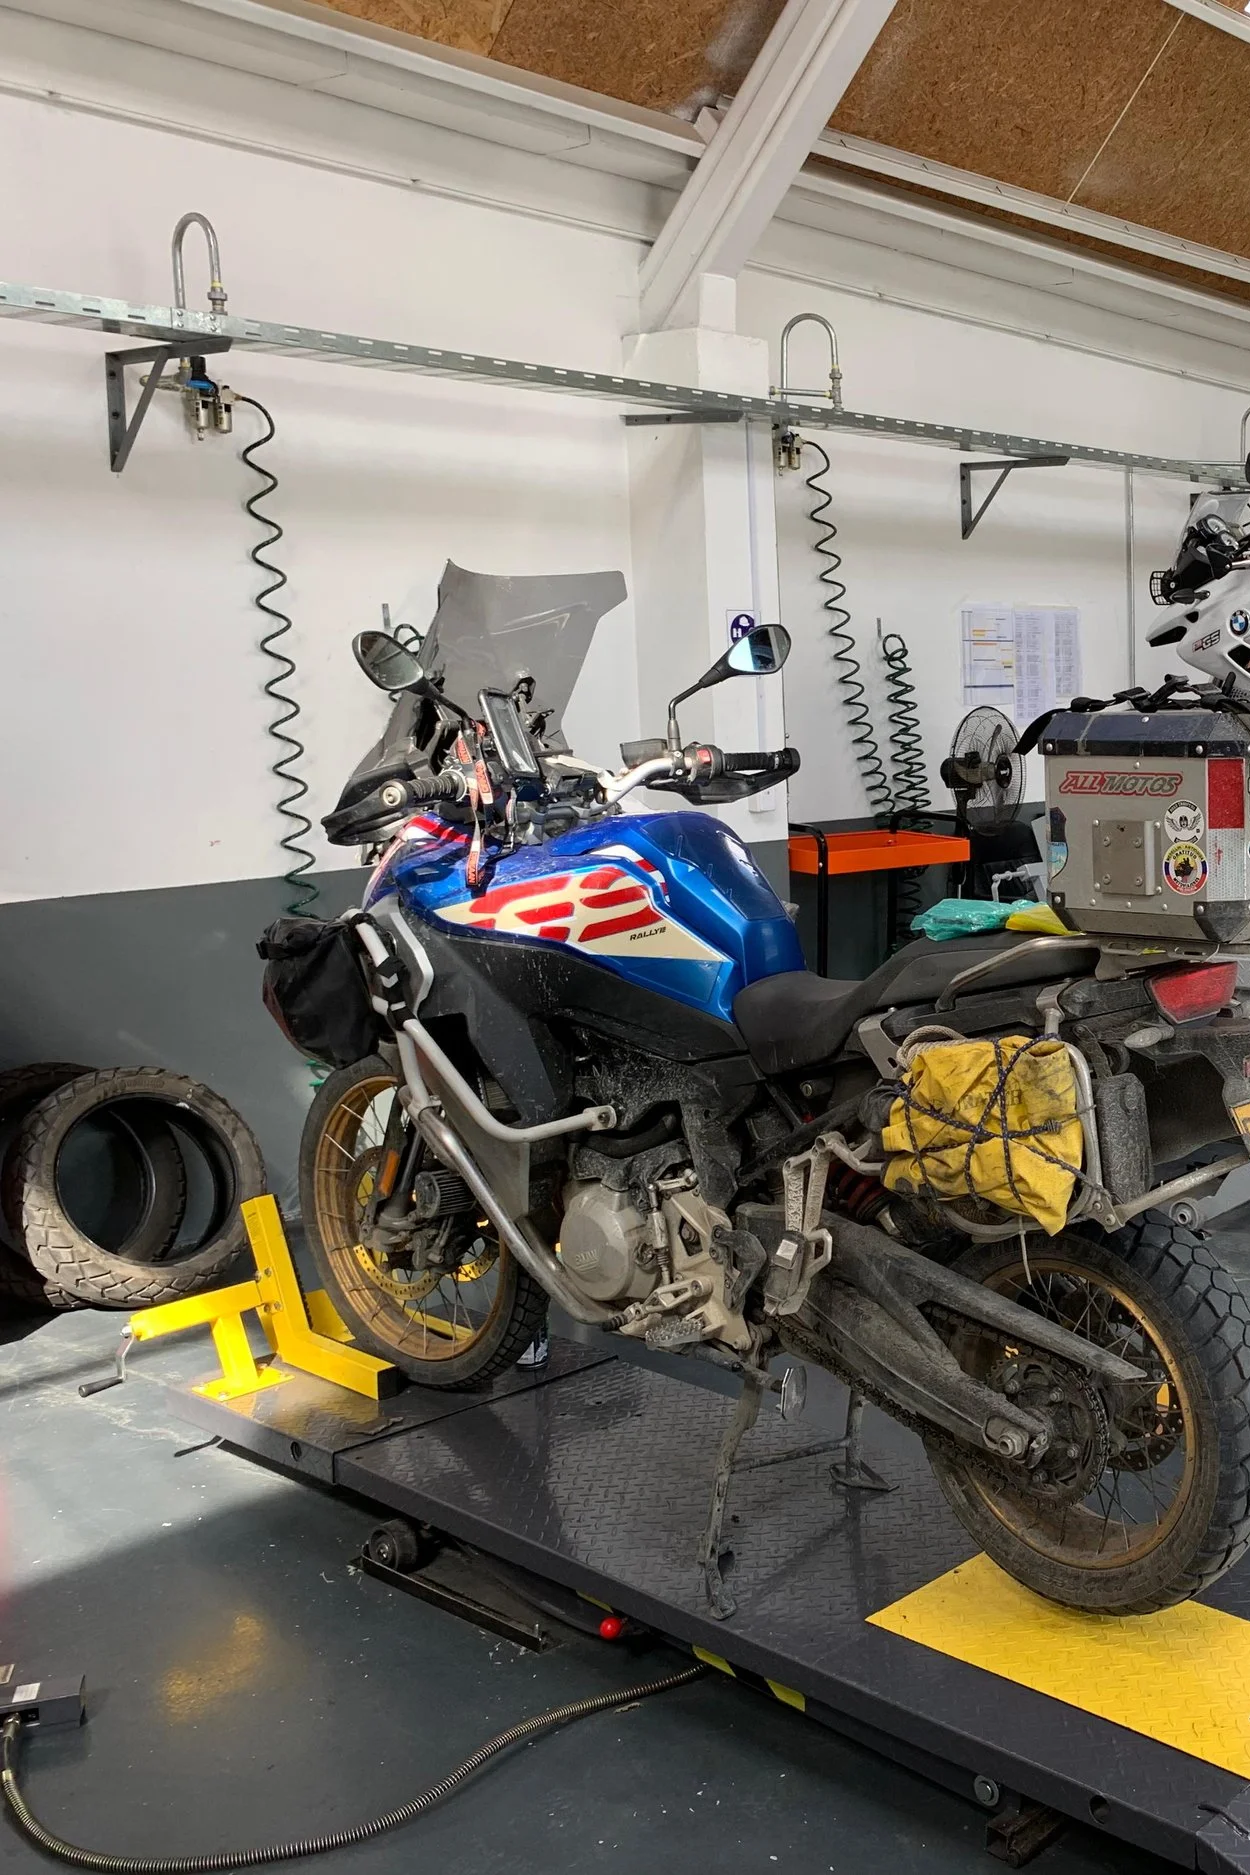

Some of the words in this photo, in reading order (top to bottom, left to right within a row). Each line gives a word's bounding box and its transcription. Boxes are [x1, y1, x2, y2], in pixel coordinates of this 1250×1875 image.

[1061, 773, 1101, 792] ALL
[1101, 773, 1181, 795] MOTOS
[629, 926, 666, 941] RALLYE
